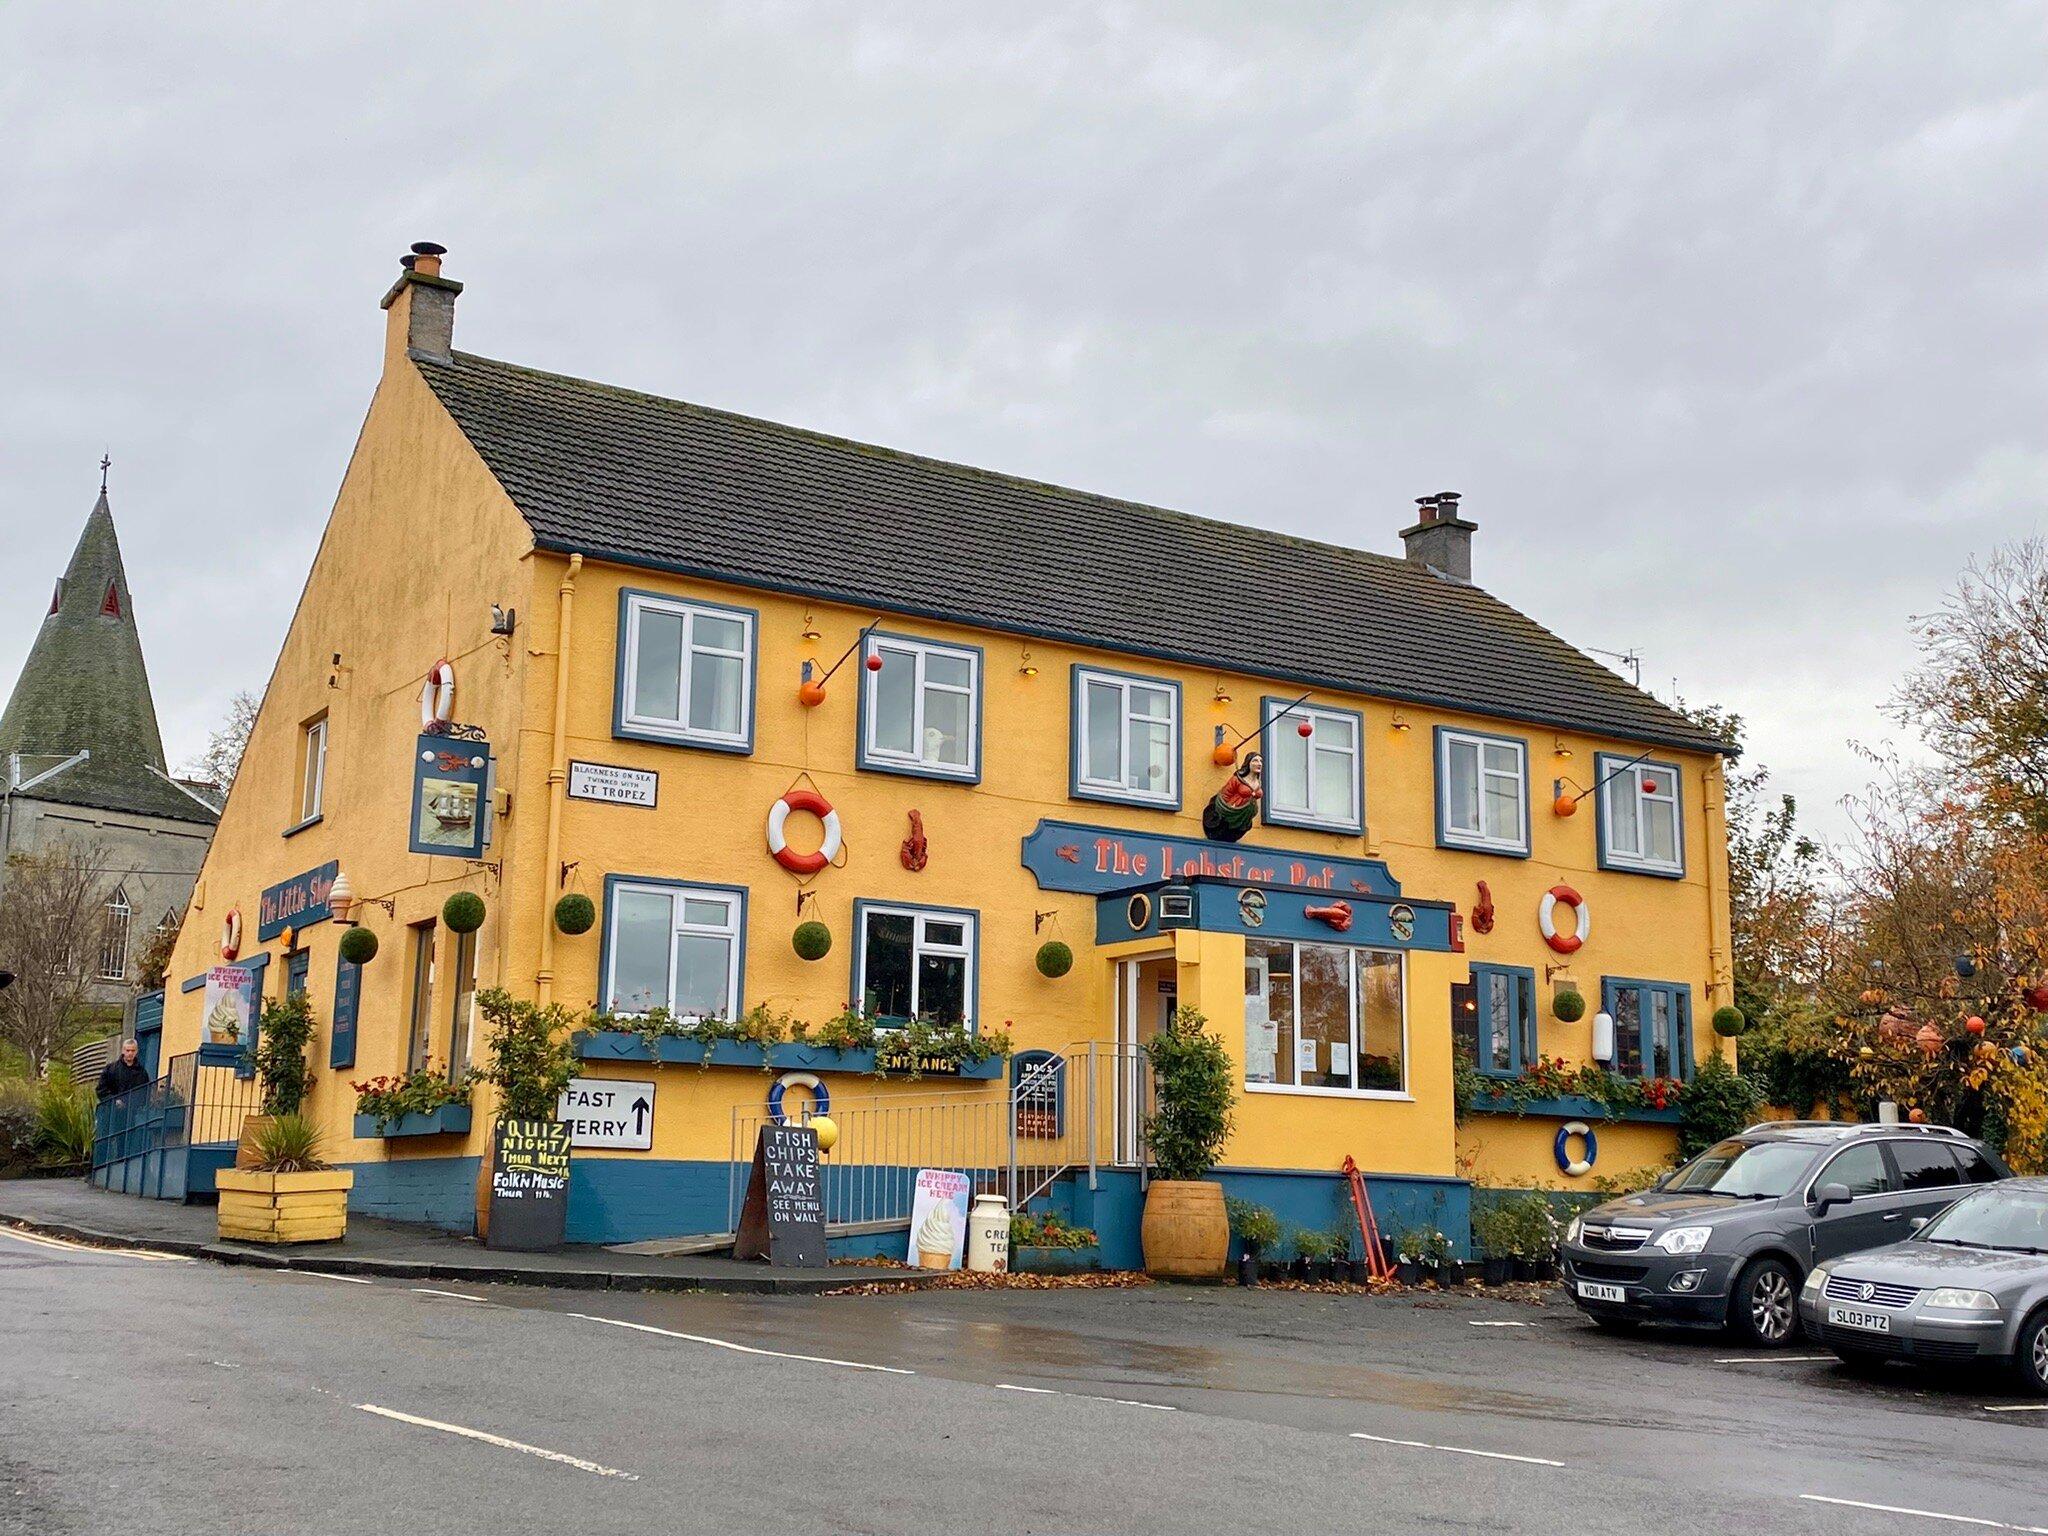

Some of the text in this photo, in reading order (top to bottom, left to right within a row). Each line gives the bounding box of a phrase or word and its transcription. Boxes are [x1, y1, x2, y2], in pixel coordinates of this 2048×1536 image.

[574, 766, 619, 777] BLACKNESS
[636, 774, 651, 782] SEA
[583, 784, 646, 801] ST TROPEZ
[1093, 838, 1335, 889] The Lobster Pot
[278, 883, 307, 920] Little
[214, 966, 247, 975] WHIPPY
[208, 973, 252, 983] ICE CREAM
[219, 981, 240, 990] HERE
[566, 1091, 616, 1108] FAST
[775, 1131, 811, 1147] FISH
[766, 1146, 815, 1163] CHIPS
[925, 1172, 963, 1183] WHIPPY
[770, 1180, 815, 1196] AWAY
[918, 1179, 968, 1192] ICE CREAM
[929, 1189, 954, 1200] HERE
[773, 1200, 820, 1211] SEE MENU
[774, 1212, 818, 1223] ON WALL
[1601, 1287, 1617, 1299] ATV
[1836, 1310, 1887, 1330] SL03 PTZ
